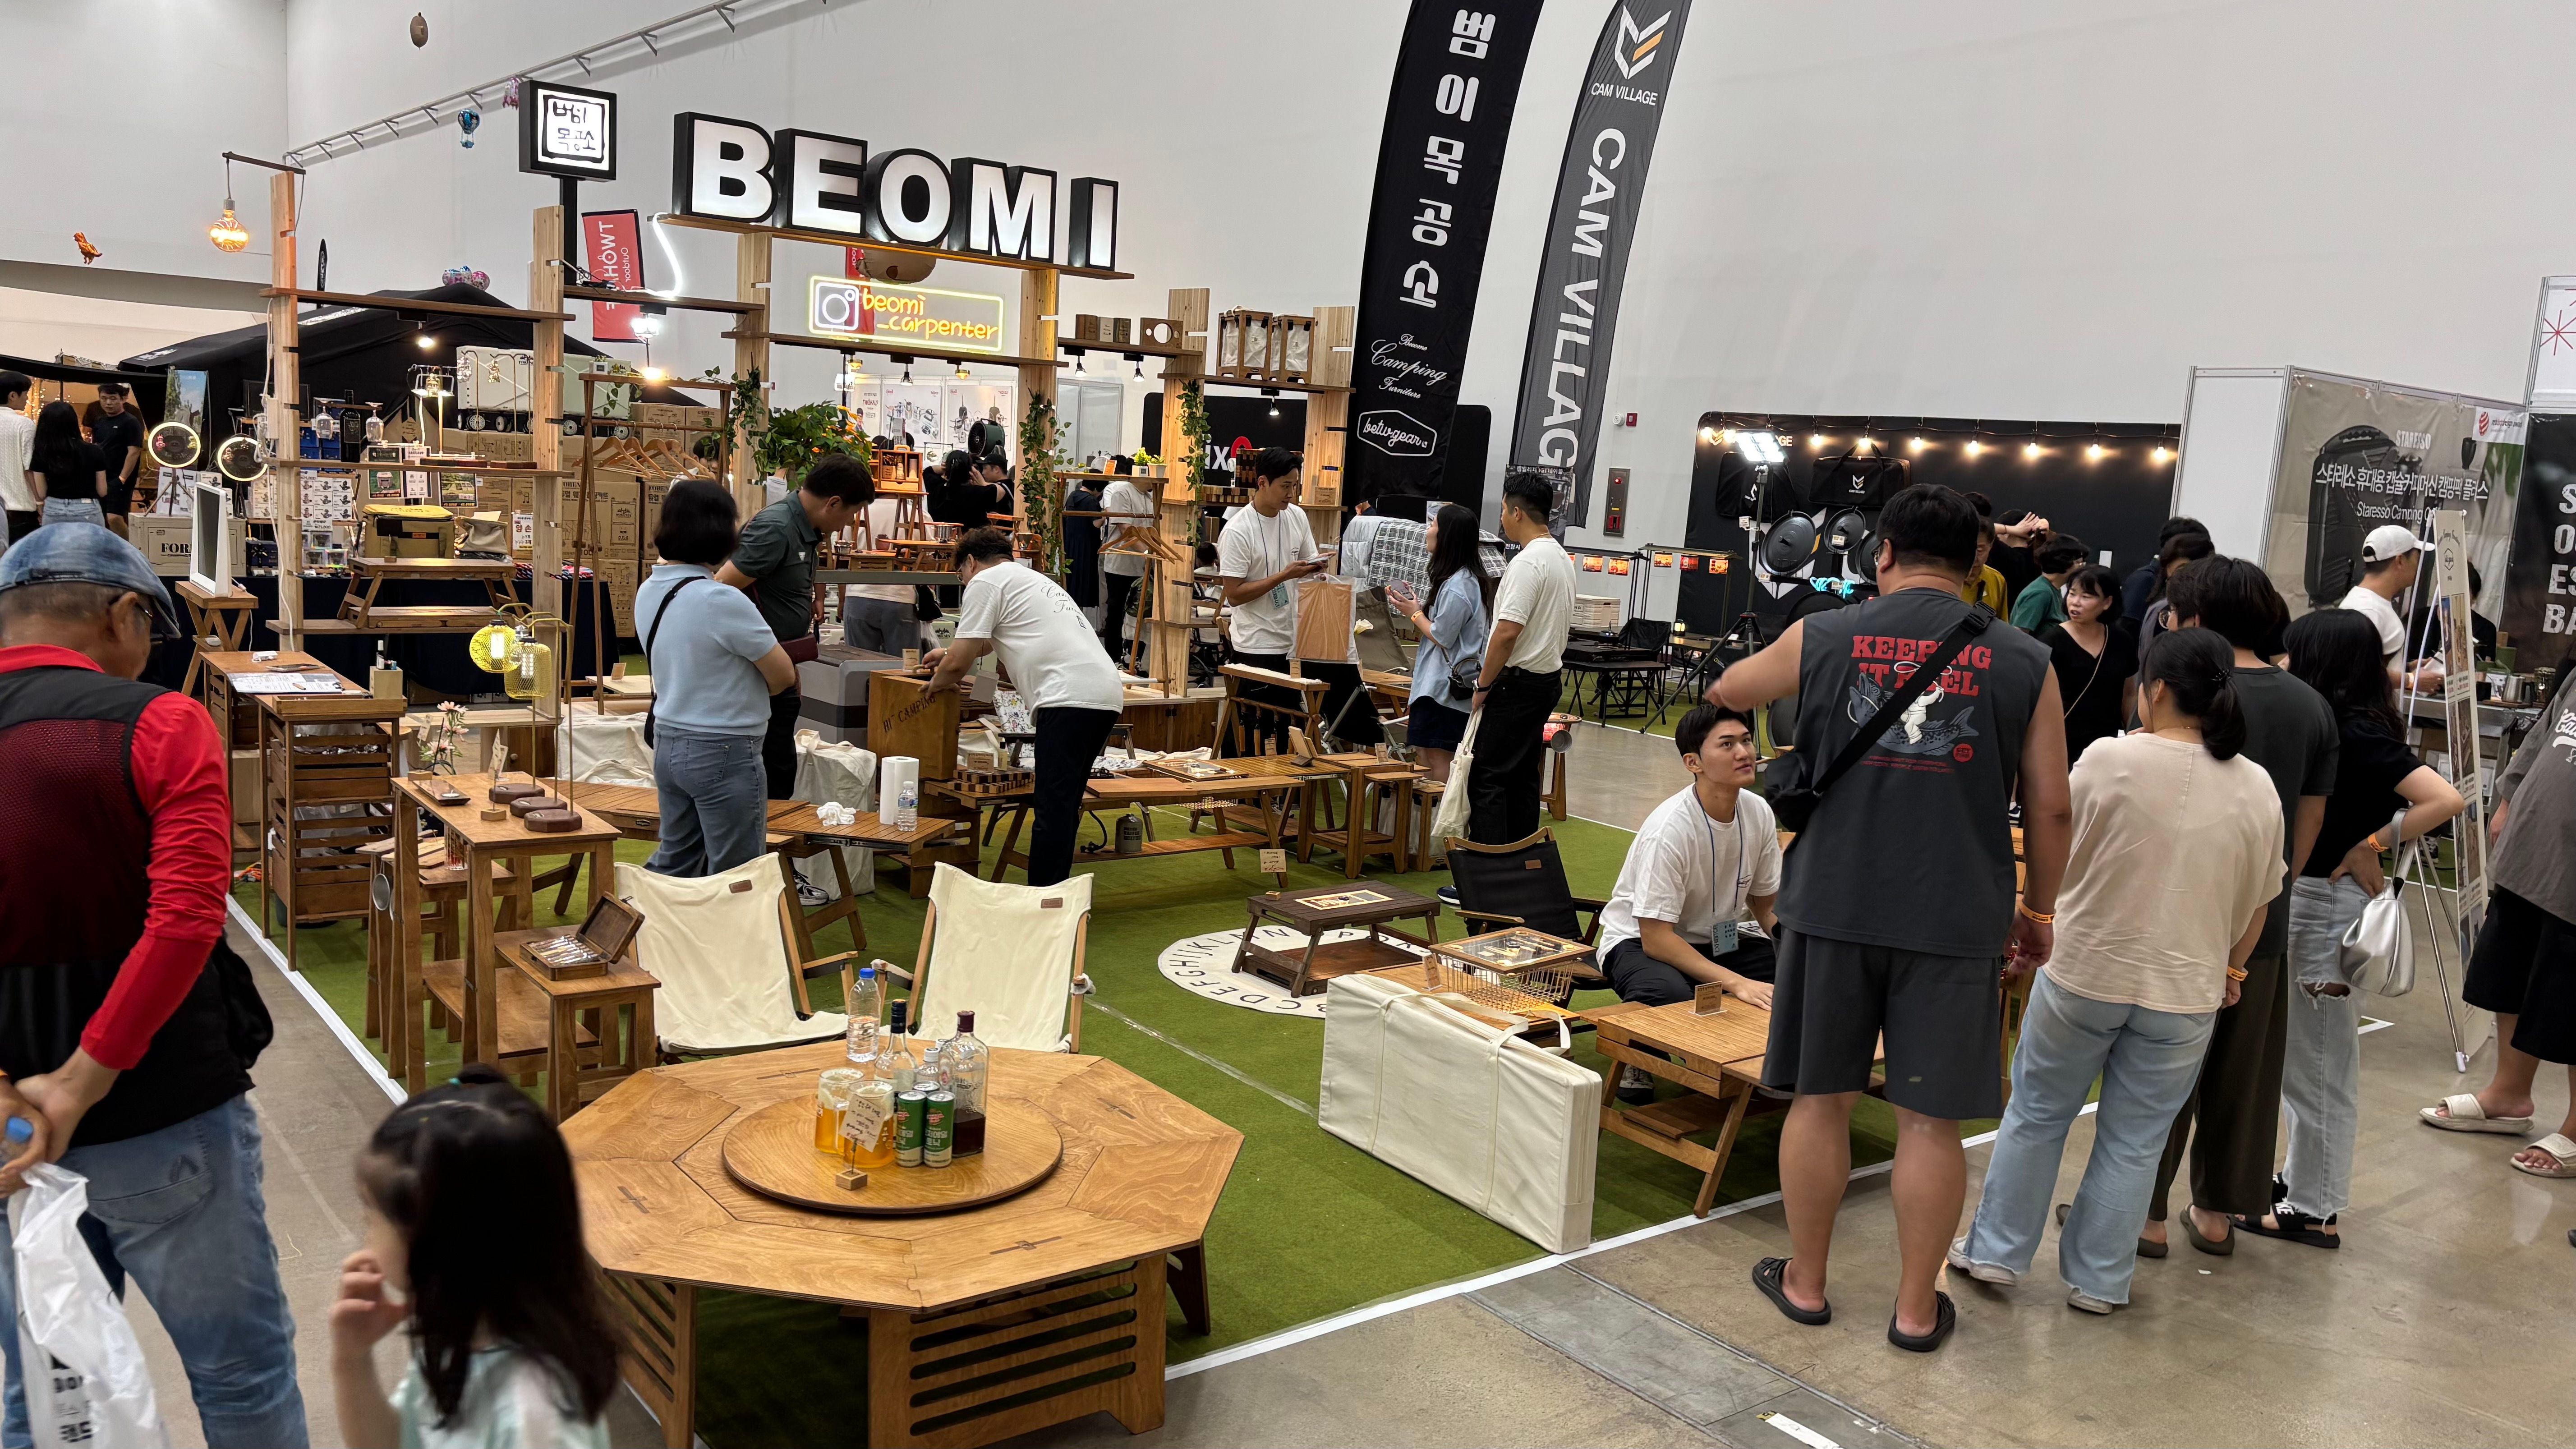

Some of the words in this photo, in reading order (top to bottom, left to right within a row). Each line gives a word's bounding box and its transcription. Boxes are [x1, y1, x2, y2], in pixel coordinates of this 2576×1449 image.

[1591, 82, 1613, 98] CAM
[1615, 86, 1659, 106] VILLAGE
[552, 101, 587, 124] 범이
[557, 127, 596, 152] 목공소
[672, 111, 1119, 271] BEOMI
[1570, 128, 1626, 259] CAM
[863, 287, 926, 316] beomi
[1399, 333, 1428, 351] Become
[1371, 339, 1448, 386] Camping
[1538, 279, 1598, 467] VILLAG
[1379, 376, 1421, 399] Furniture
[2315, 462, 2356, 489] 스타레소
[2356, 466, 2385, 493] 휴대용
[2462, 478, 2489, 502] 플러스
[2357, 501, 2390, 519] Staresso
[2391, 504, 2424, 524] Camping
[161, 543, 192, 553] FOR
[2554, 524, 2576, 555] O
[1851, 635, 1992, 670] KEEPNG
[1894, 665, 1979, 697] REL
